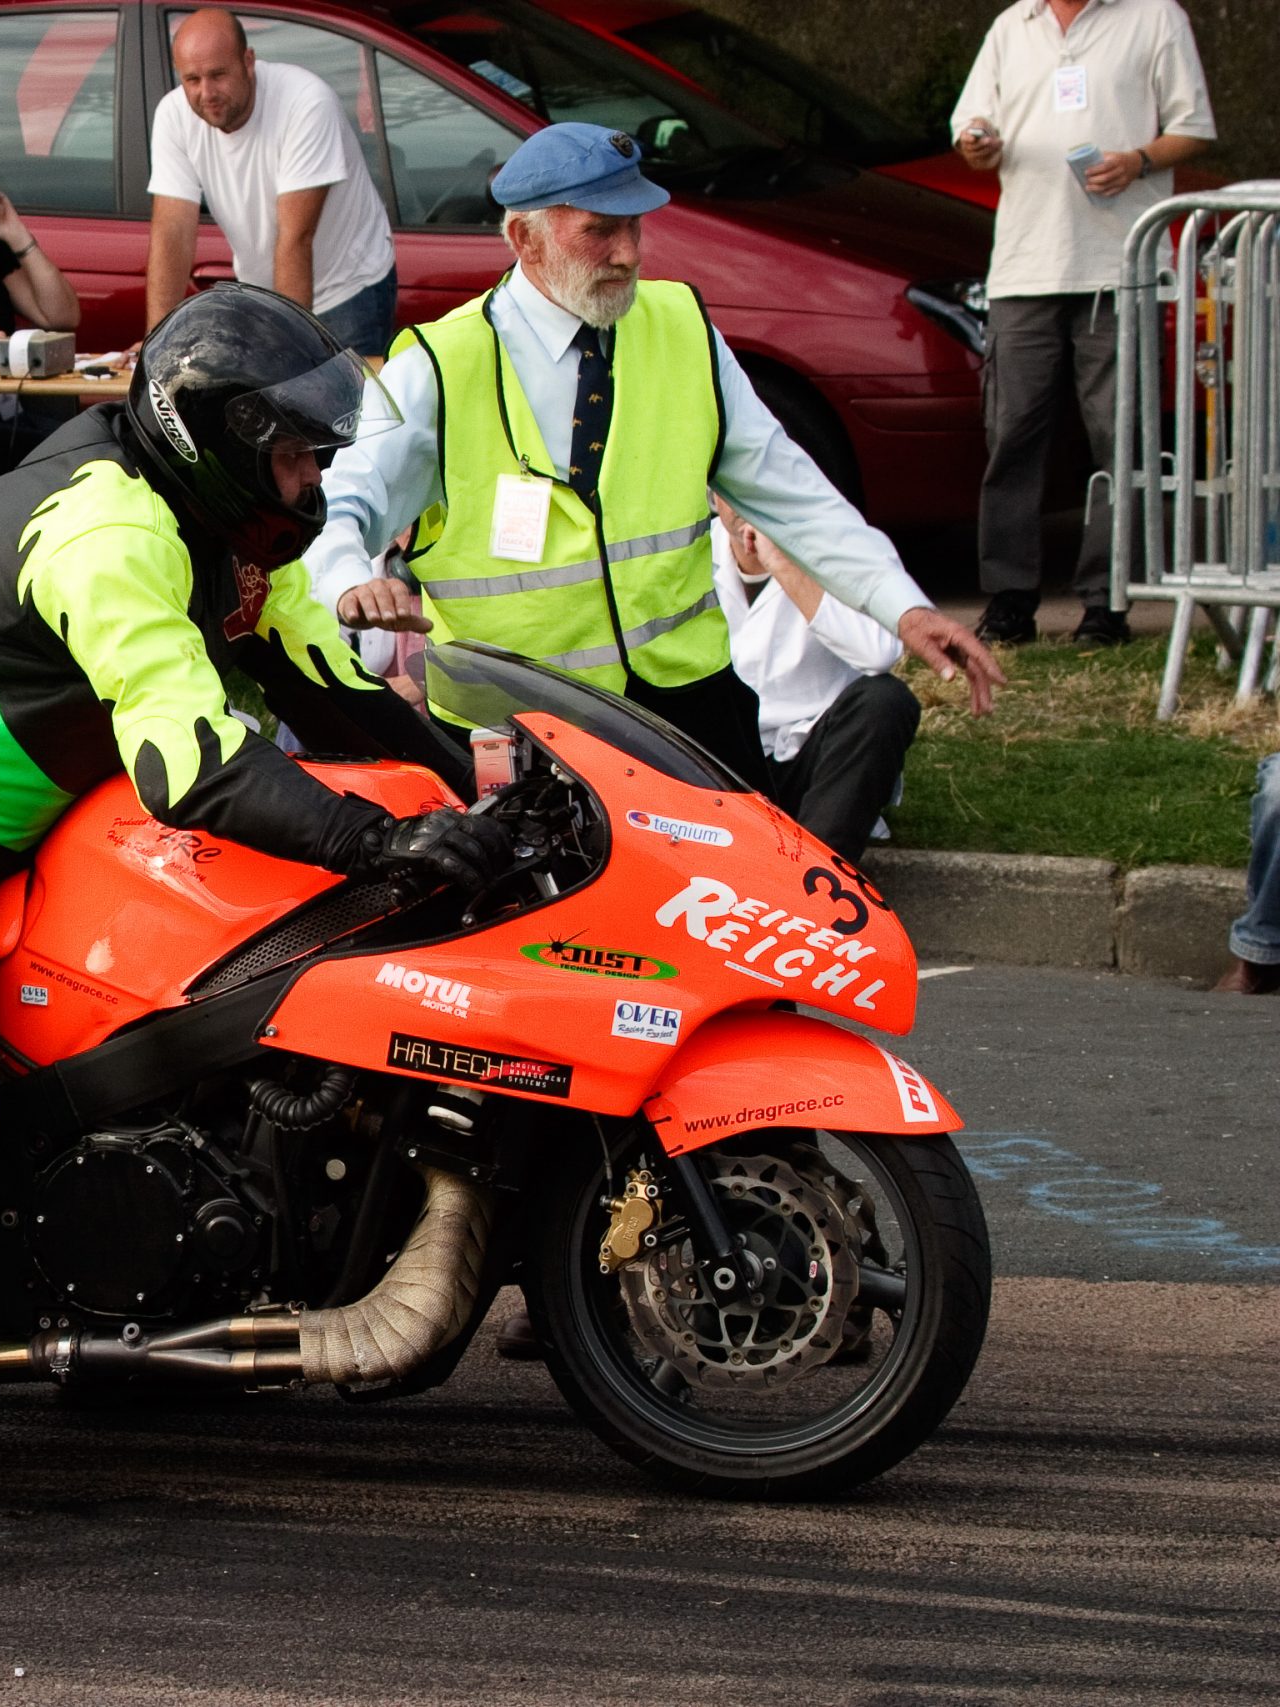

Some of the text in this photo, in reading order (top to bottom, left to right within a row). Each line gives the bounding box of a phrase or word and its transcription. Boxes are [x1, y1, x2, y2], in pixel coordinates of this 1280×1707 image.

[151, 381, 191, 452] Nitro
[653, 815, 719, 843] tecnium
[655, 876, 877, 963] REIFEN
[561, 947, 648, 972] JUST
[29, 960, 119, 1005] www.dragrace.cc
[375, 962, 472, 1009] MOTUL
[605, 969, 640, 979] DESIGN
[420, 998, 468, 1019] MOTOR OIL
[616, 1002, 678, 1029] OVER
[393, 1038, 504, 1080] HALTECH
[510, 1060, 542, 1072] ENGINE
[508, 1075, 547, 1088] SYSTEMS
[509, 1069, 567, 1084] MANAGEMENT
[684, 1093, 845, 1133] www.dragrace.cc
